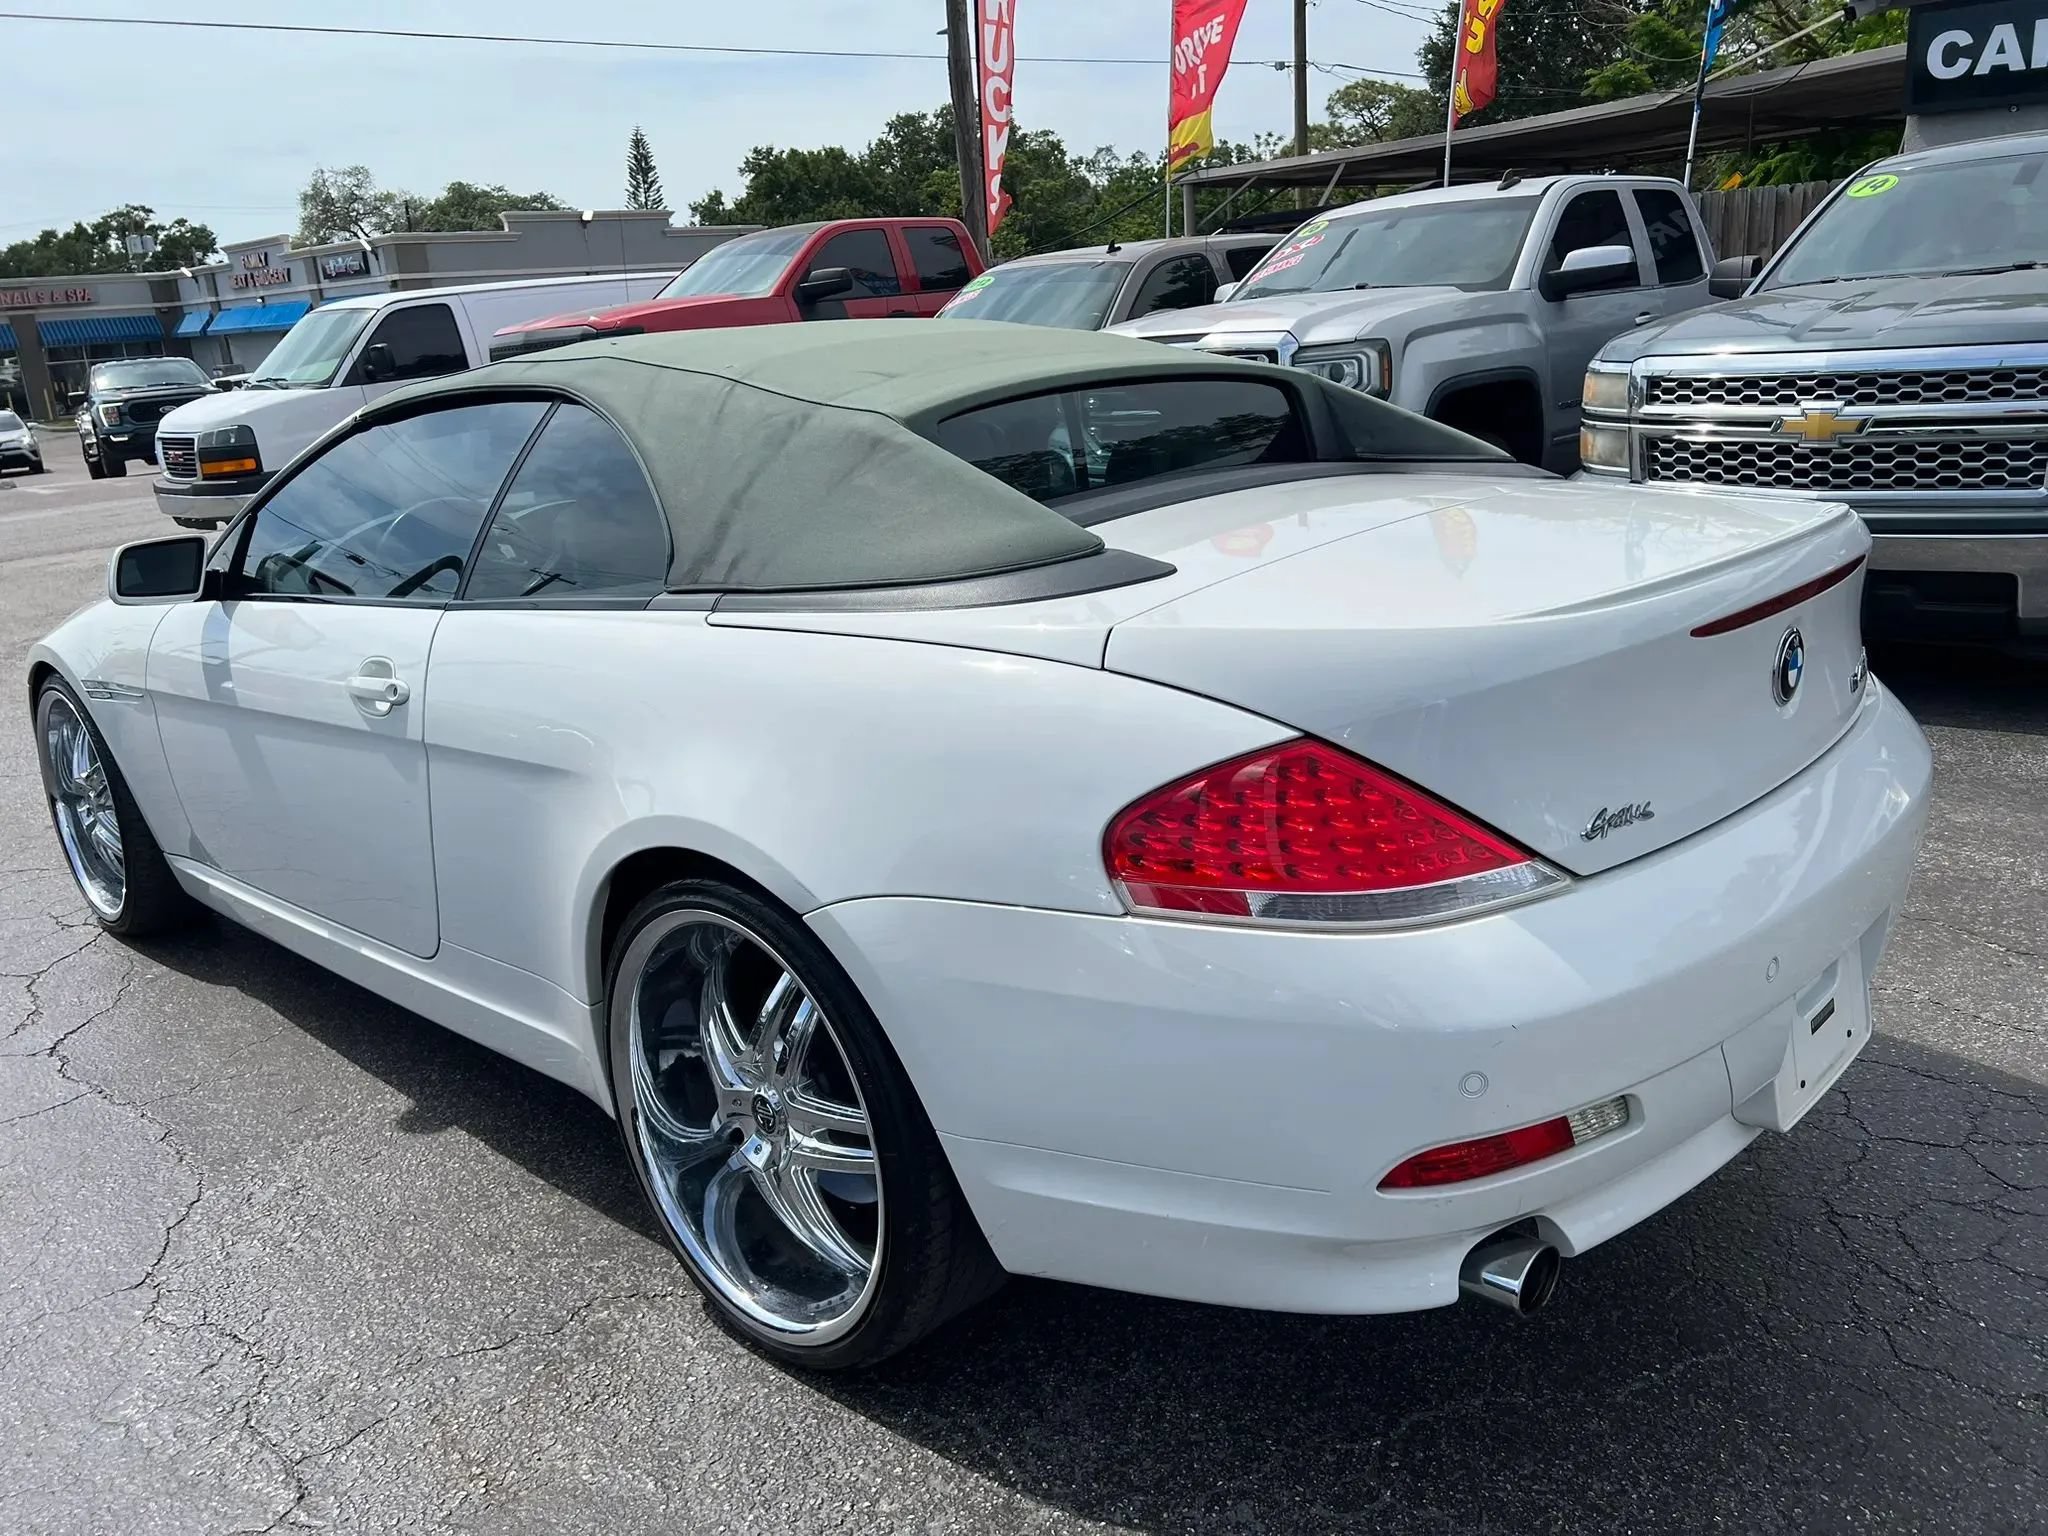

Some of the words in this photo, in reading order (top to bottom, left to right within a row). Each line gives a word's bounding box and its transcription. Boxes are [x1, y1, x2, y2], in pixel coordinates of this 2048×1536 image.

[1174, 14, 1225, 75] DRIVE
[0, 287, 46, 305] NAILS
[66, 287, 92, 303] SPA
